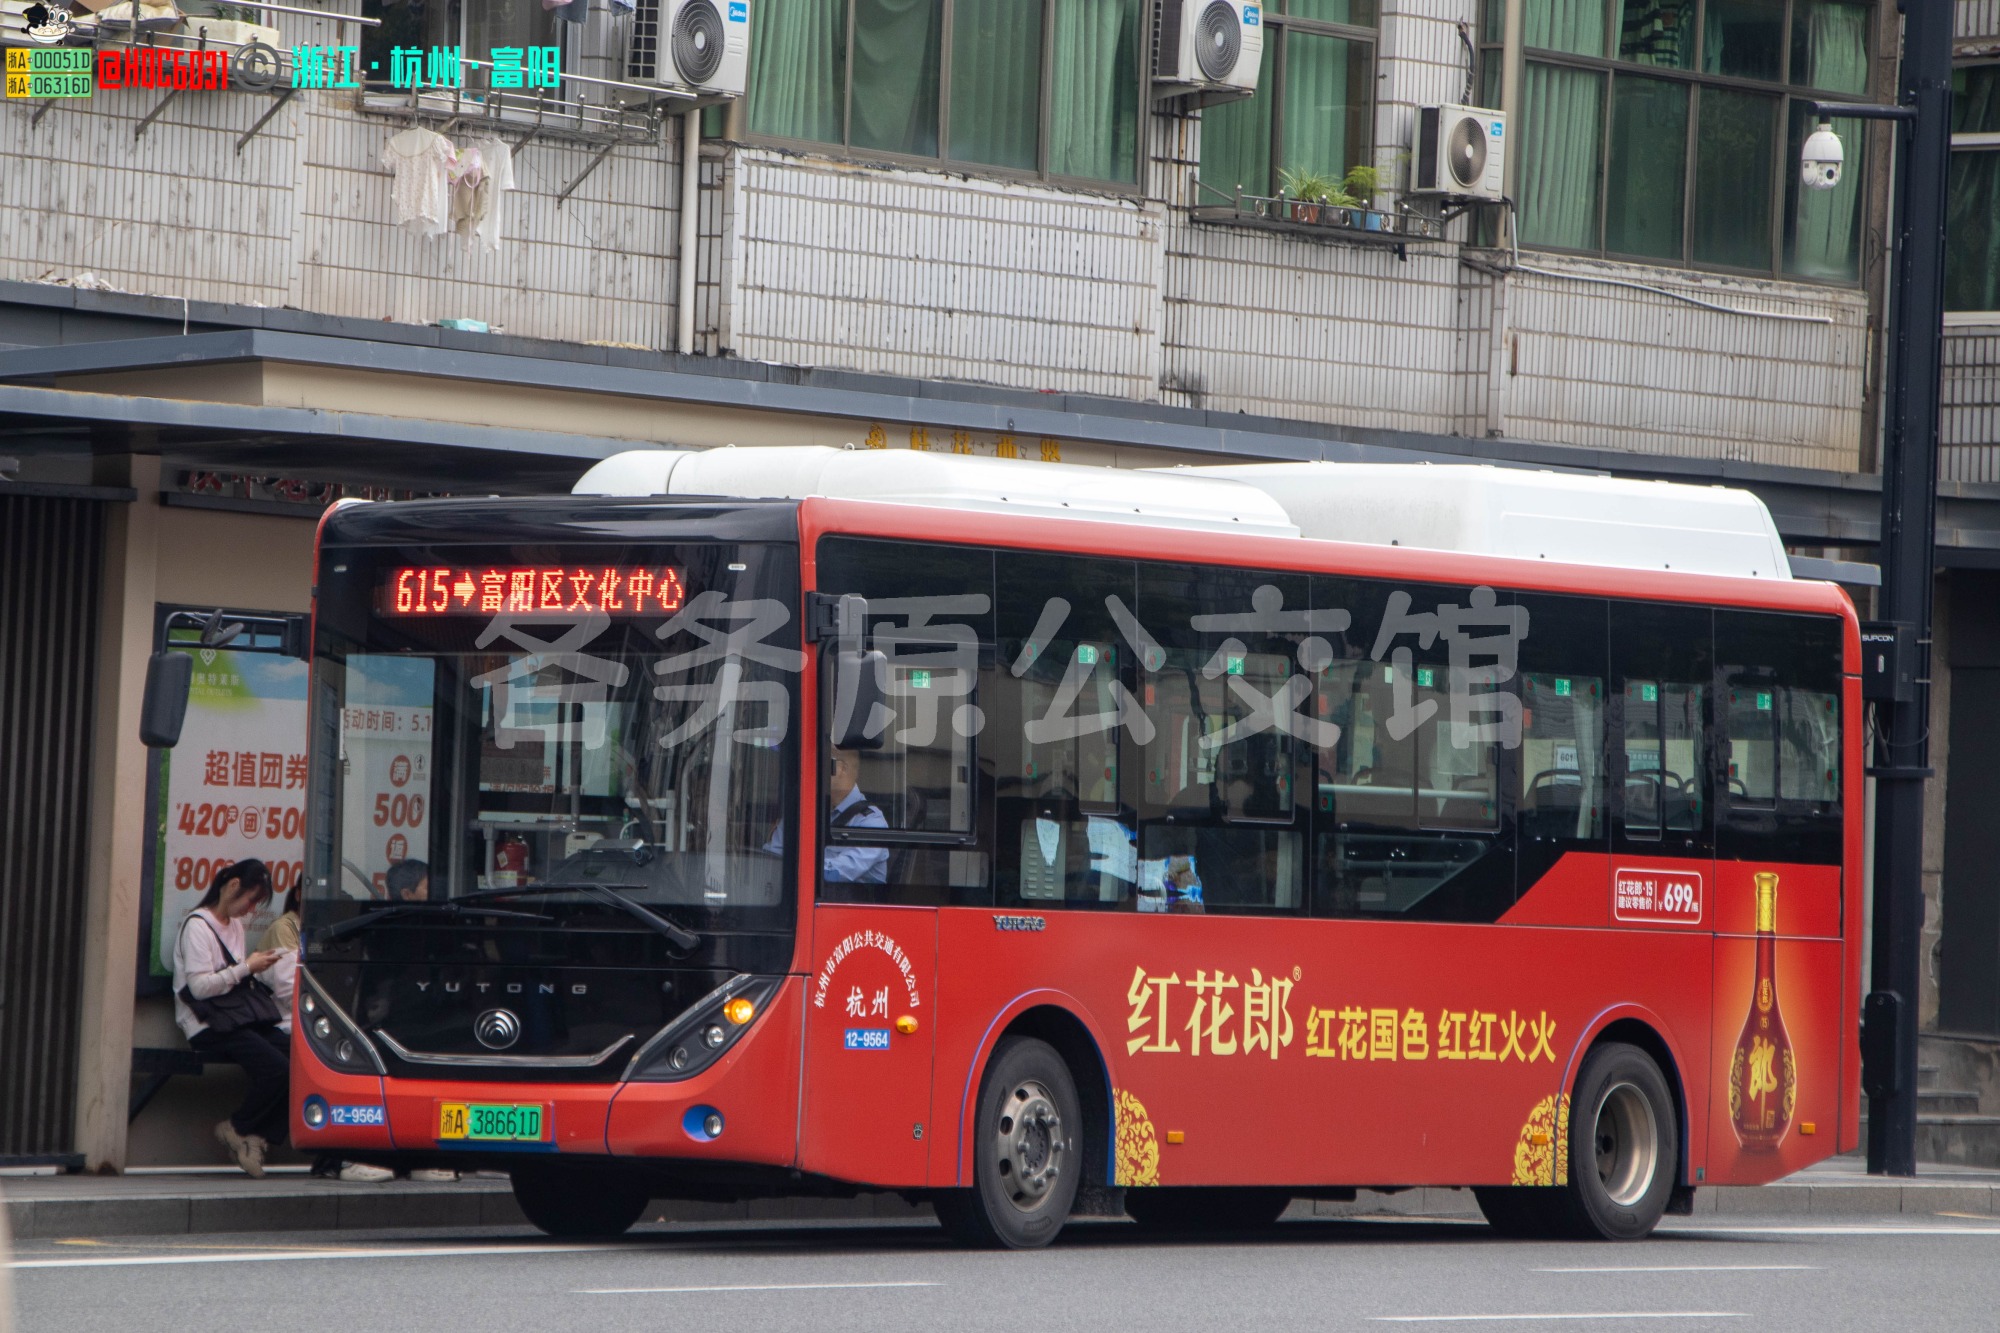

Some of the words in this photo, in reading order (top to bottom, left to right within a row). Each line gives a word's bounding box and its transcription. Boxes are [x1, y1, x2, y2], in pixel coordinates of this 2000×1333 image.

[398, 570, 450, 612] 615
[480, 568, 683, 612] 富阳区文化中心
[203, 750, 307, 790] 超值团券
[373, 793, 424, 828] 500
[1618, 896, 1653, 910] 建议零售价
[993, 915, 1046, 931] YUTONG
[814, 929, 920, 1009] 杭州市富阳公共交通有限公司
[416, 981, 587, 995] YUTONG
[845, 985, 889, 1019] 杭州
[846, 1032, 888, 1047] 12-9564
[1305, 1005, 1430, 1061] 红花国色
[1437, 1008, 1557, 1064] 红红火火
[330, 1107, 384, 1124] 12-9564
